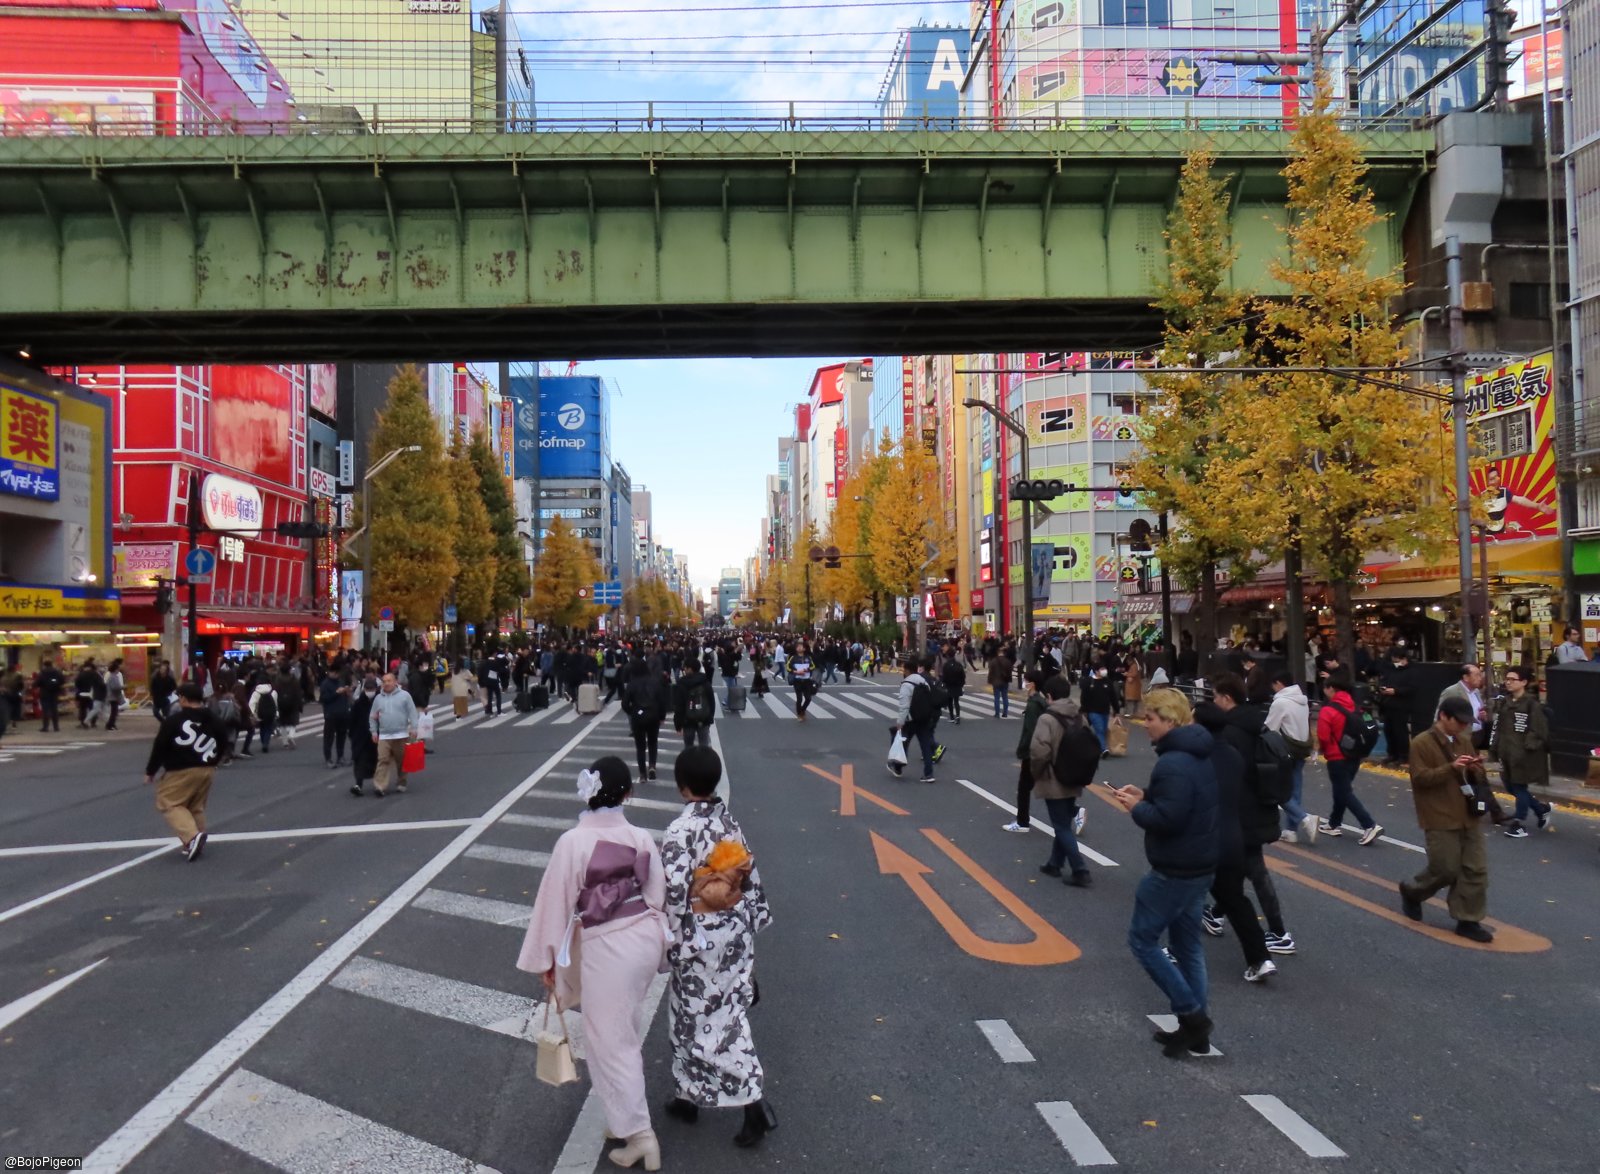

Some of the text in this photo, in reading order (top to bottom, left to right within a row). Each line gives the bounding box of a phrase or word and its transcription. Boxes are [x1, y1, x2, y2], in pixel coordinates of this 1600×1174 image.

[7, 397, 50, 463] 薬
[312, 470, 328, 492] GPS
[219, 536, 244, 563] 1号館
